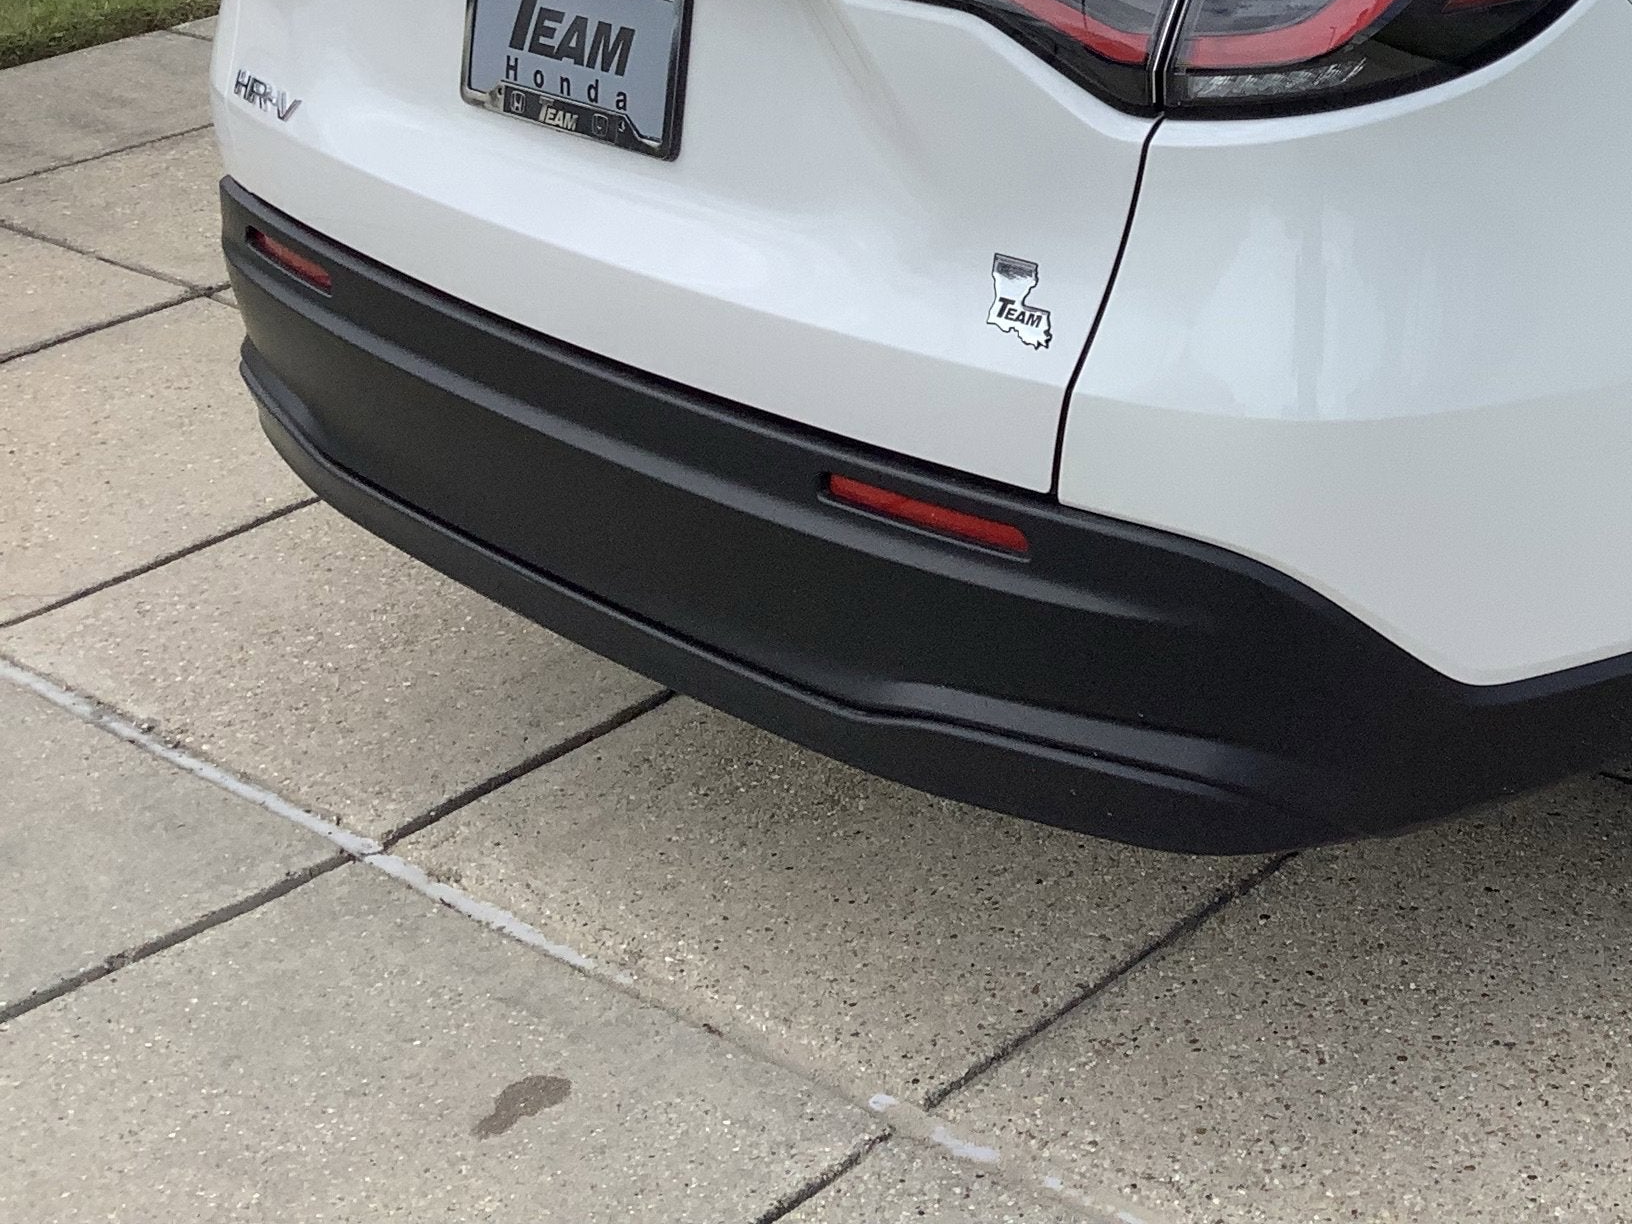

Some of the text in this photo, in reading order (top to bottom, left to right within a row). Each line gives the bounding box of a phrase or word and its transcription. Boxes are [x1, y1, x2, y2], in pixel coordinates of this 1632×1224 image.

[505, 55, 628, 112] Honda
[538, 96, 578, 131] TEAM
[996, 296, 1043, 328] TEAM
